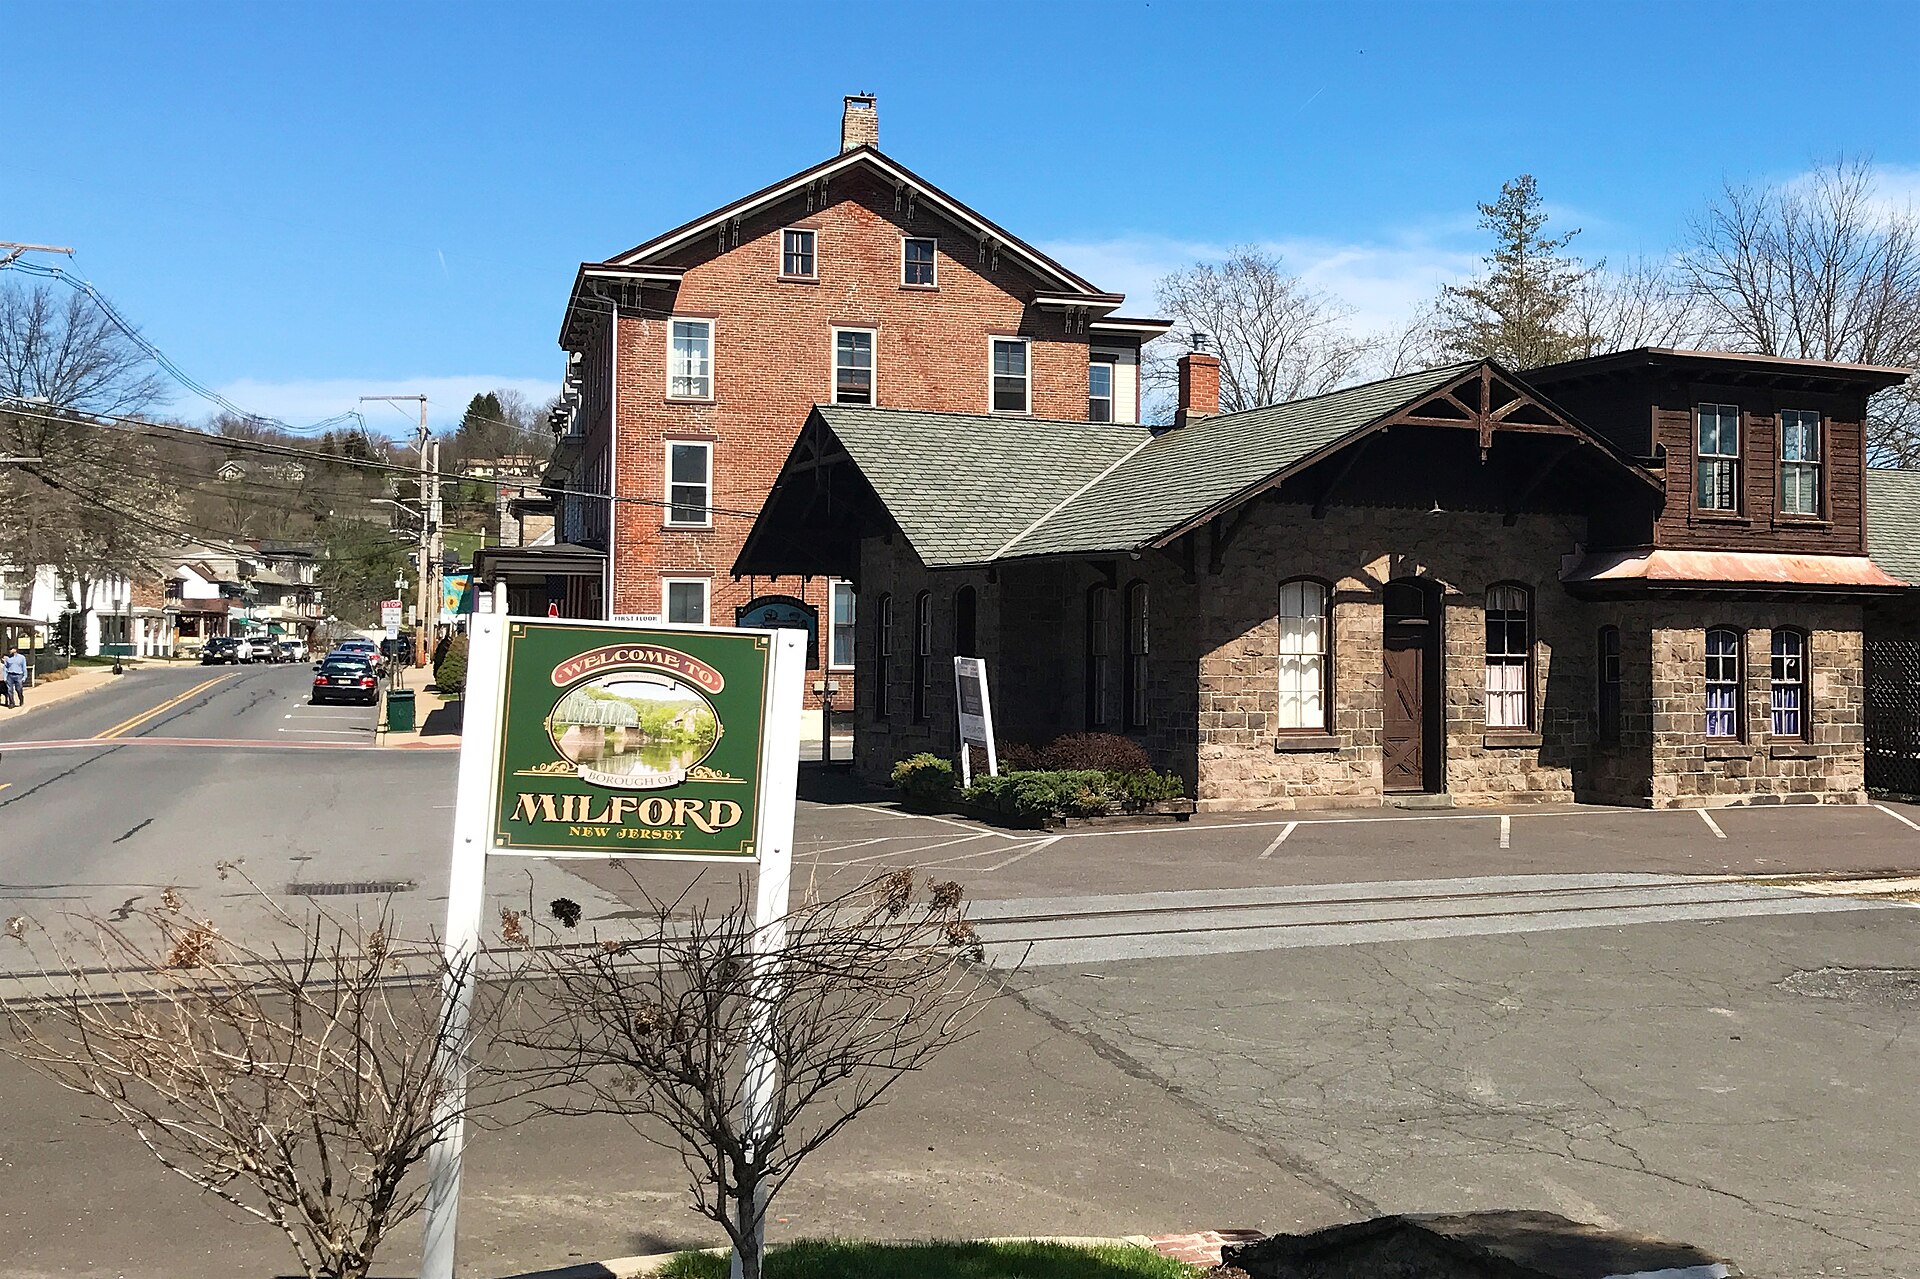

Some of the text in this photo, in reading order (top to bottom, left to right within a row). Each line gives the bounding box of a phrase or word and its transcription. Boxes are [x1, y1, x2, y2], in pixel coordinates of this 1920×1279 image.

[562, 649, 713, 682] WELCOME TO
[588, 772, 675, 786] BOROUGH OF
[509, 792, 744, 834] MILFORD
[569, 826, 685, 840] NEW JERSEY
